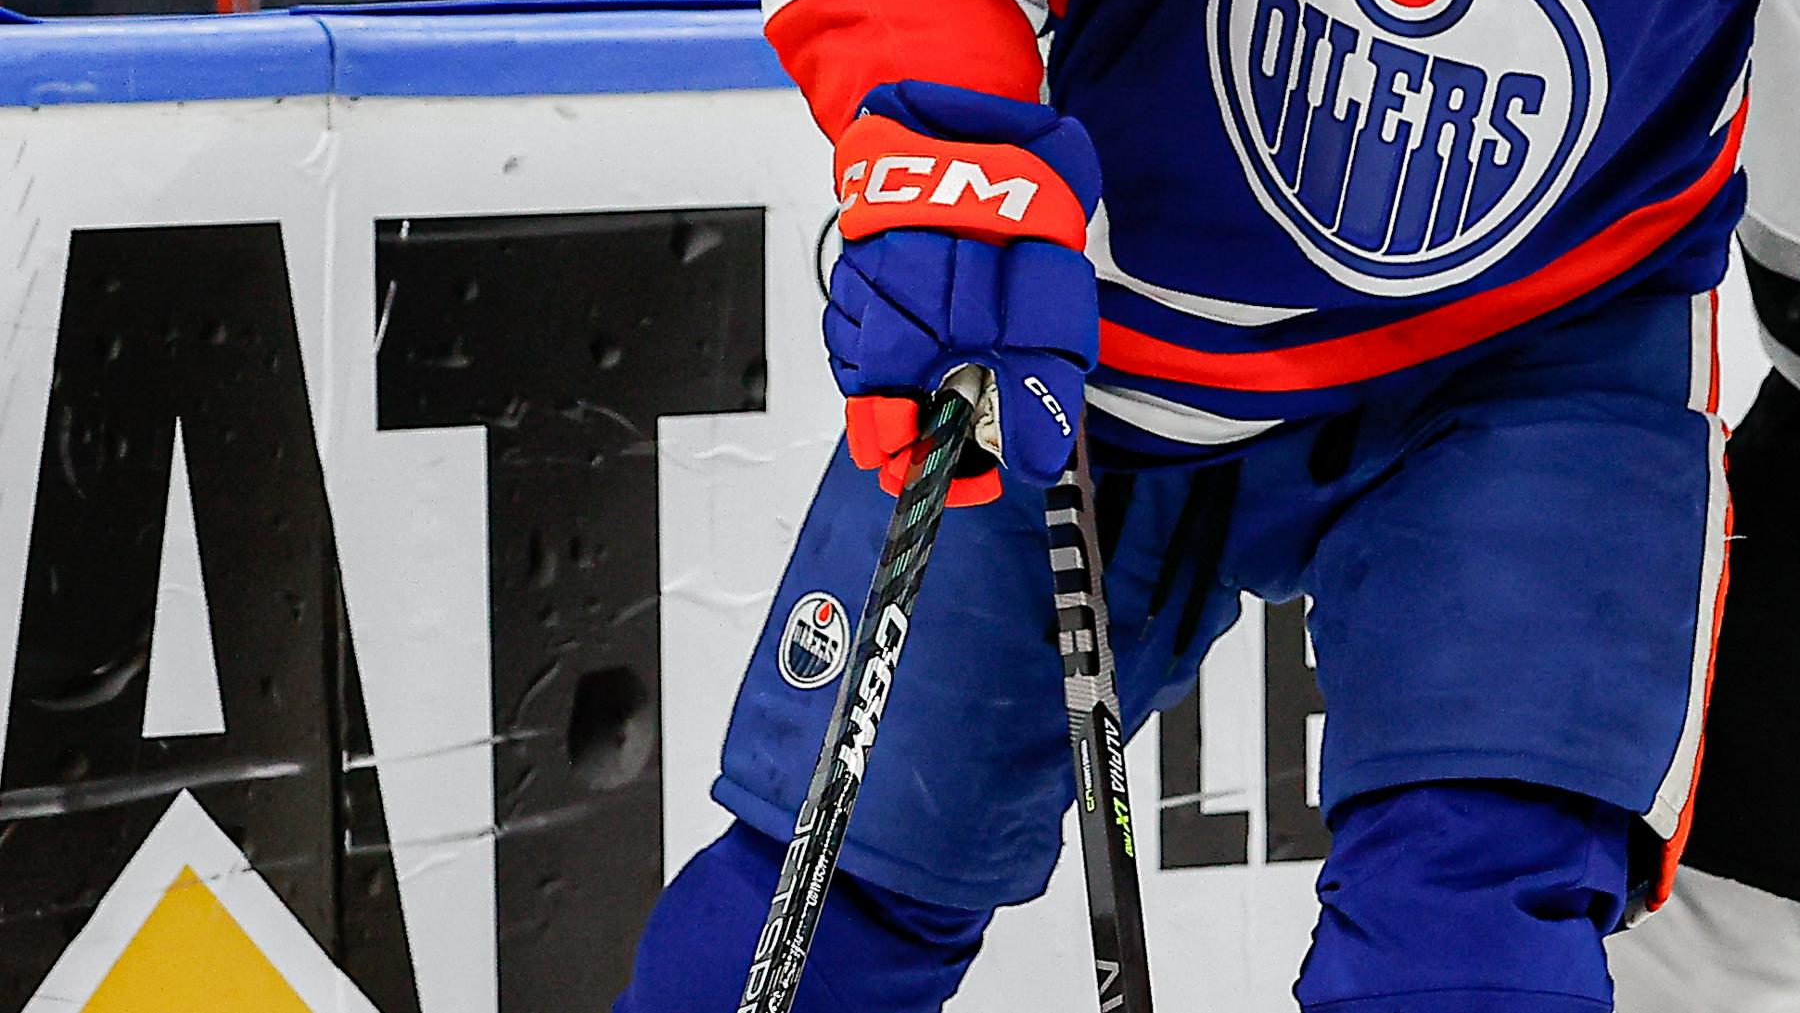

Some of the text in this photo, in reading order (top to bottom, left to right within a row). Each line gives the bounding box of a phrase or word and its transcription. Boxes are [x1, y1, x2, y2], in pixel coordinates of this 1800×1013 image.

[840, 155, 1039, 222] CCM
[1023, 376, 1072, 436] CCM
[0, 207, 767, 1013] AT
[1103, 716, 1125, 794] ALPHA
[1160, 594, 1333, 870] LE
